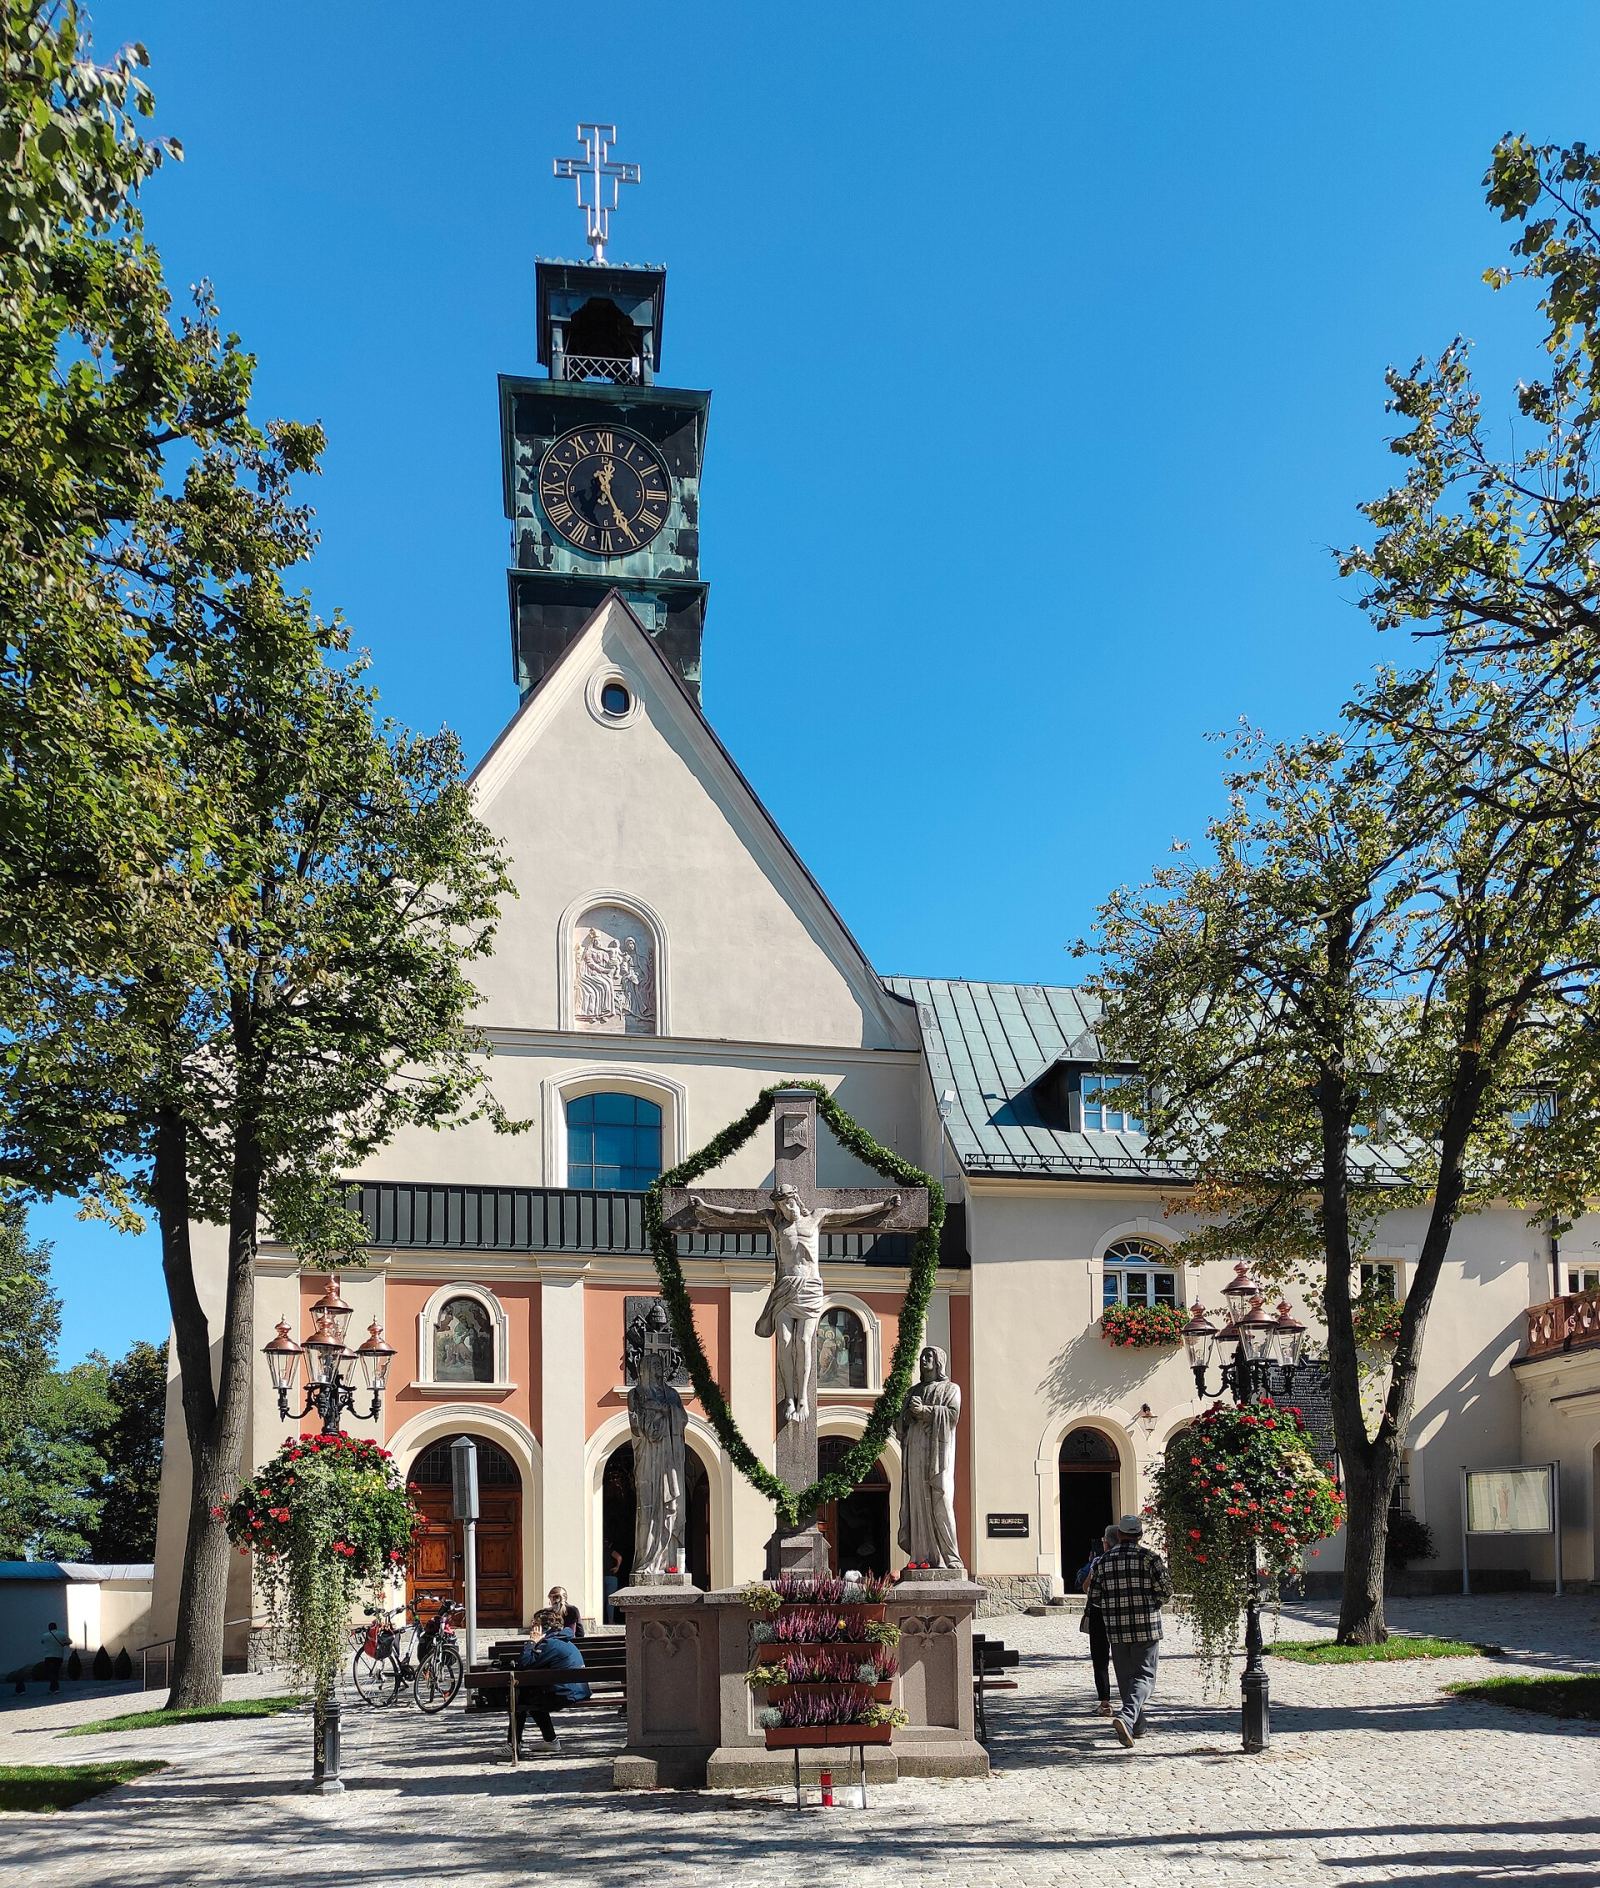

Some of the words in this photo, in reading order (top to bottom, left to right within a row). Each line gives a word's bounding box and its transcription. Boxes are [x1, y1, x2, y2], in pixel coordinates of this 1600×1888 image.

[568, 435, 590, 460] XI
[595, 432, 614, 453] XII
[624, 442, 636, 460] I
[549, 454, 572, 474] X
[639, 463, 659, 477] II
[542, 481, 565, 496] IX
[646, 489, 668, 502] III
[549, 501, 573, 526] VIII
[638, 508, 663, 531] IIII
[569, 521, 590, 545] VII
[600, 530, 614, 551] VI
